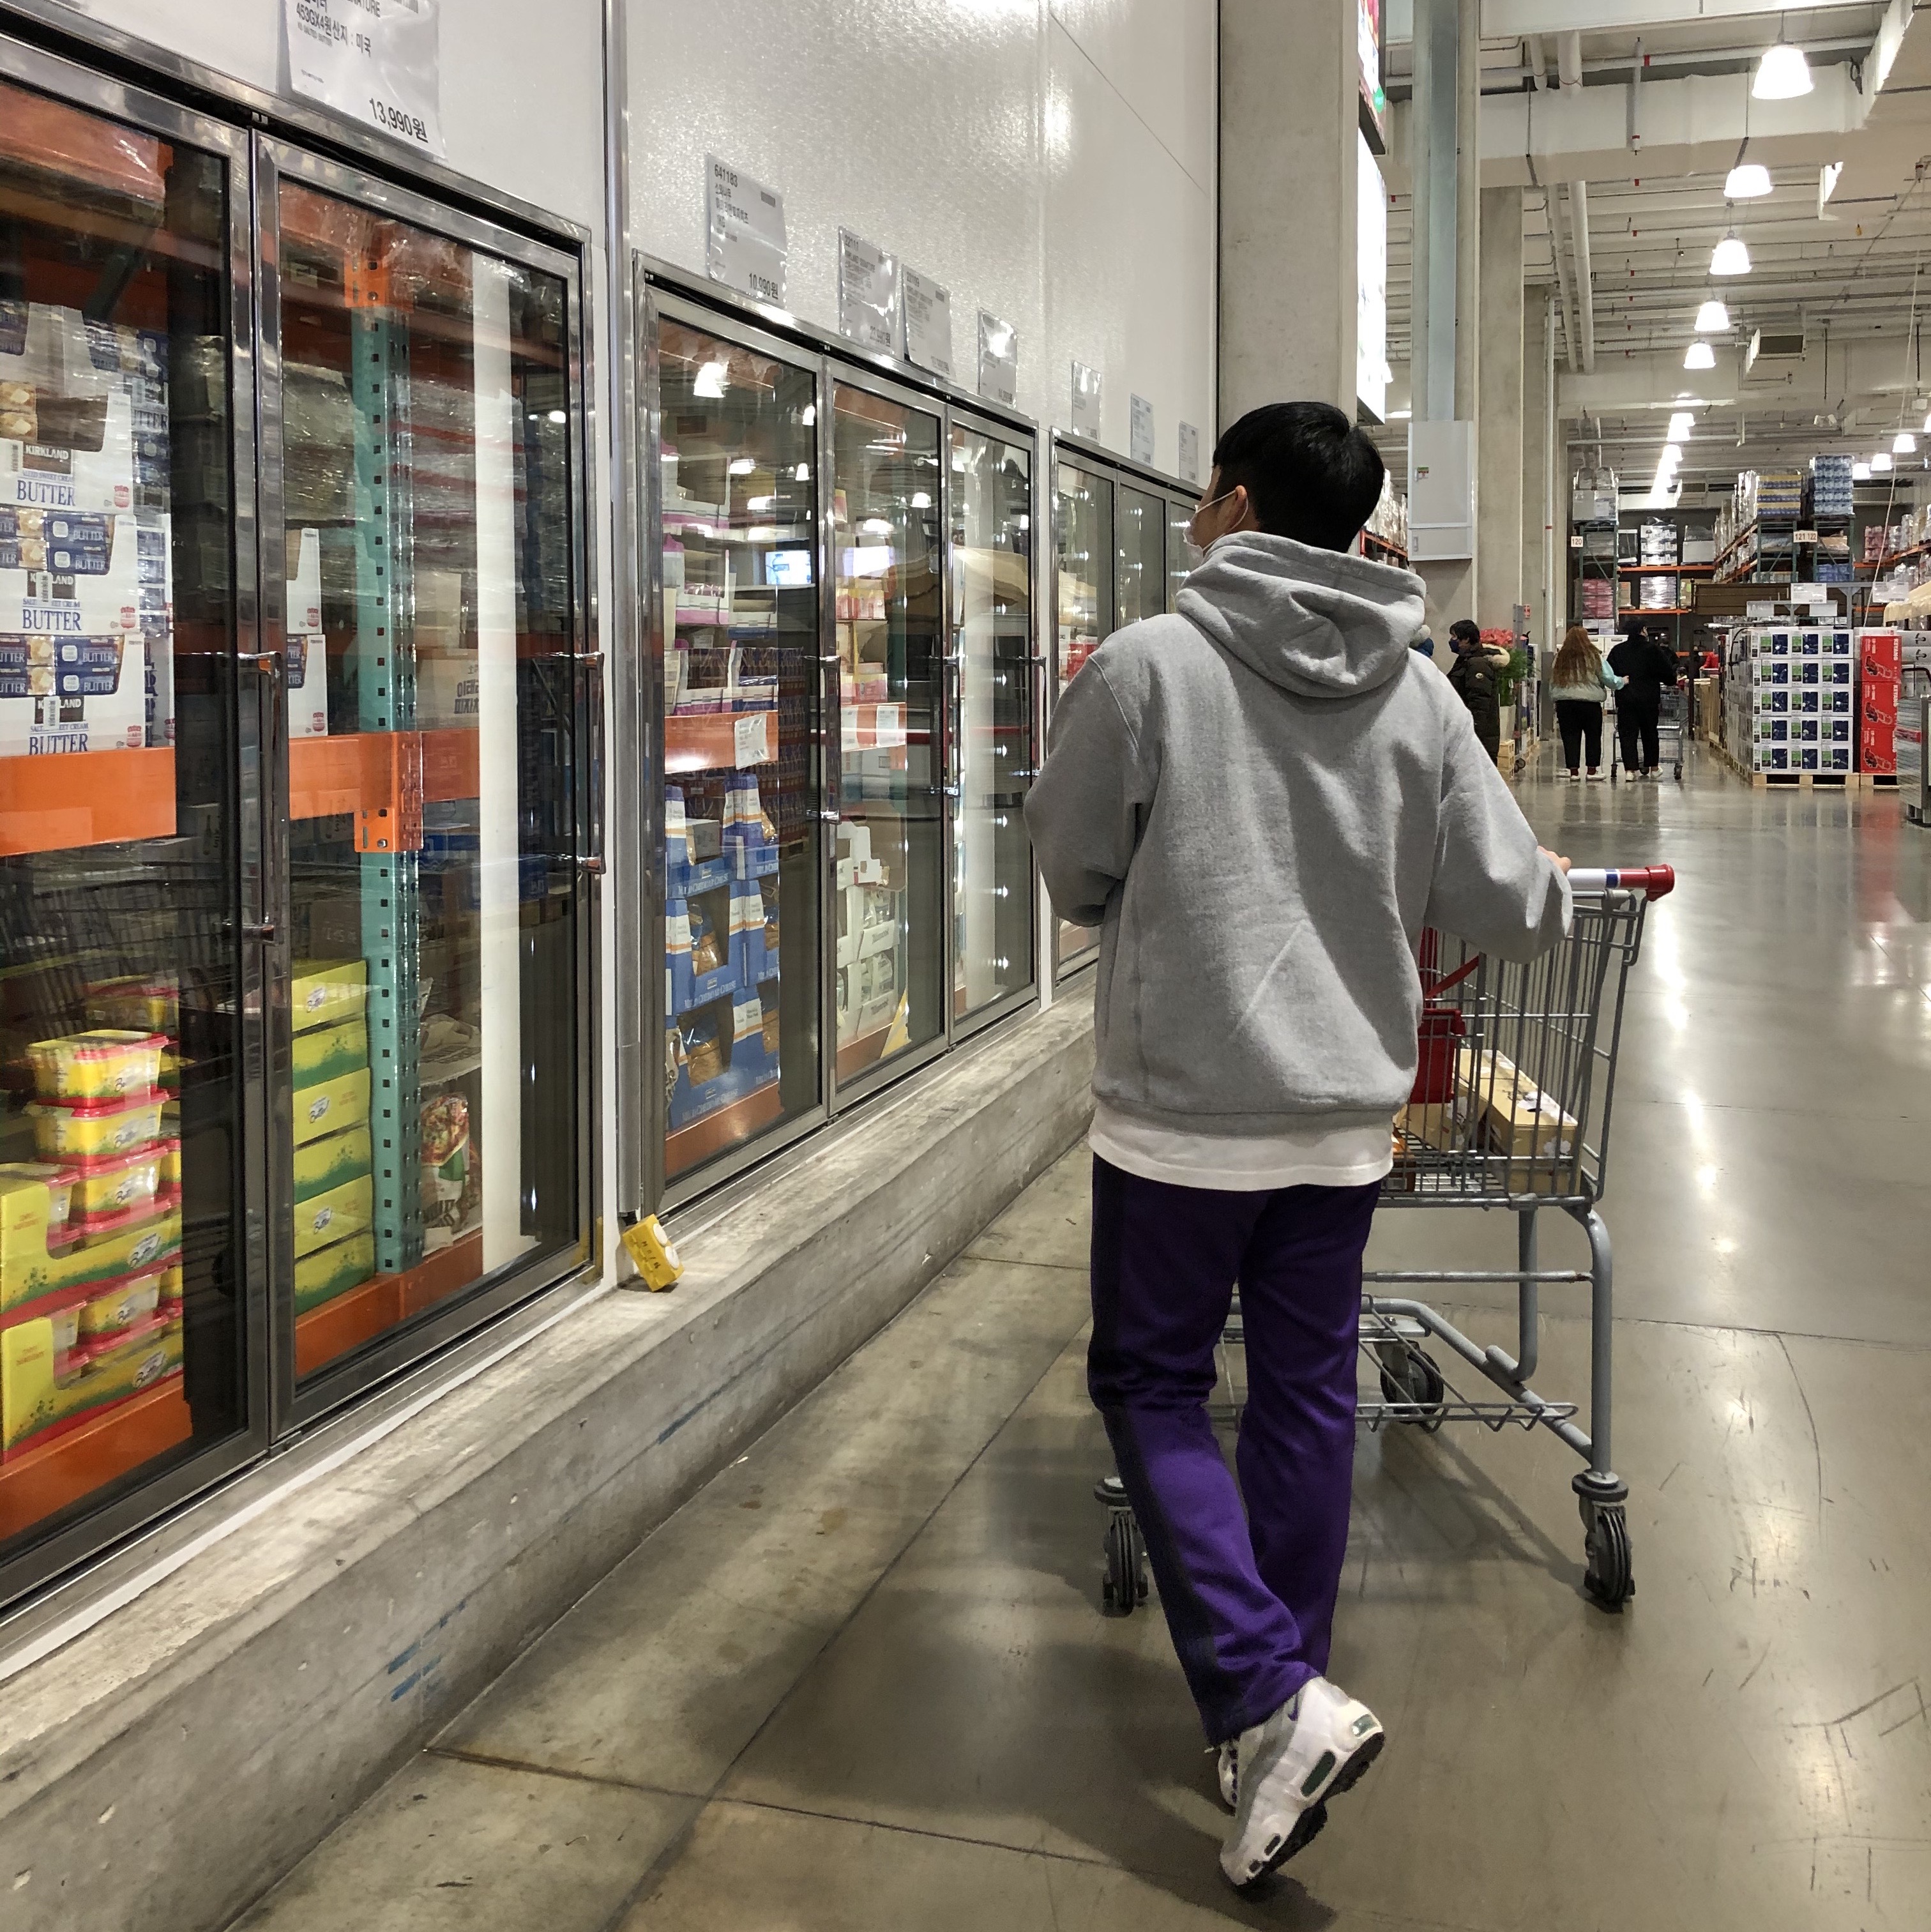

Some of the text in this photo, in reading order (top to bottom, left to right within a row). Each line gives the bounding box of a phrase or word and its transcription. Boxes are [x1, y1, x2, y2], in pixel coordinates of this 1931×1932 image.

[356, 33, 371, 57] 미국
[369, 97, 428, 143] 13,990원
[715, 164, 738, 188] 641183
[26, 445, 70, 460] KIRKLAND
[17, 480, 76, 506] BUTTER
[75, 559, 105, 570] BUTTER
[22, 609, 82, 630] BUTTER
[83, 652, 115, 662] BUTTER
[84, 681, 114, 692] BUTTER
[29, 733, 88, 755] BUTTER
[720, 980, 736, 994] CHEESE
